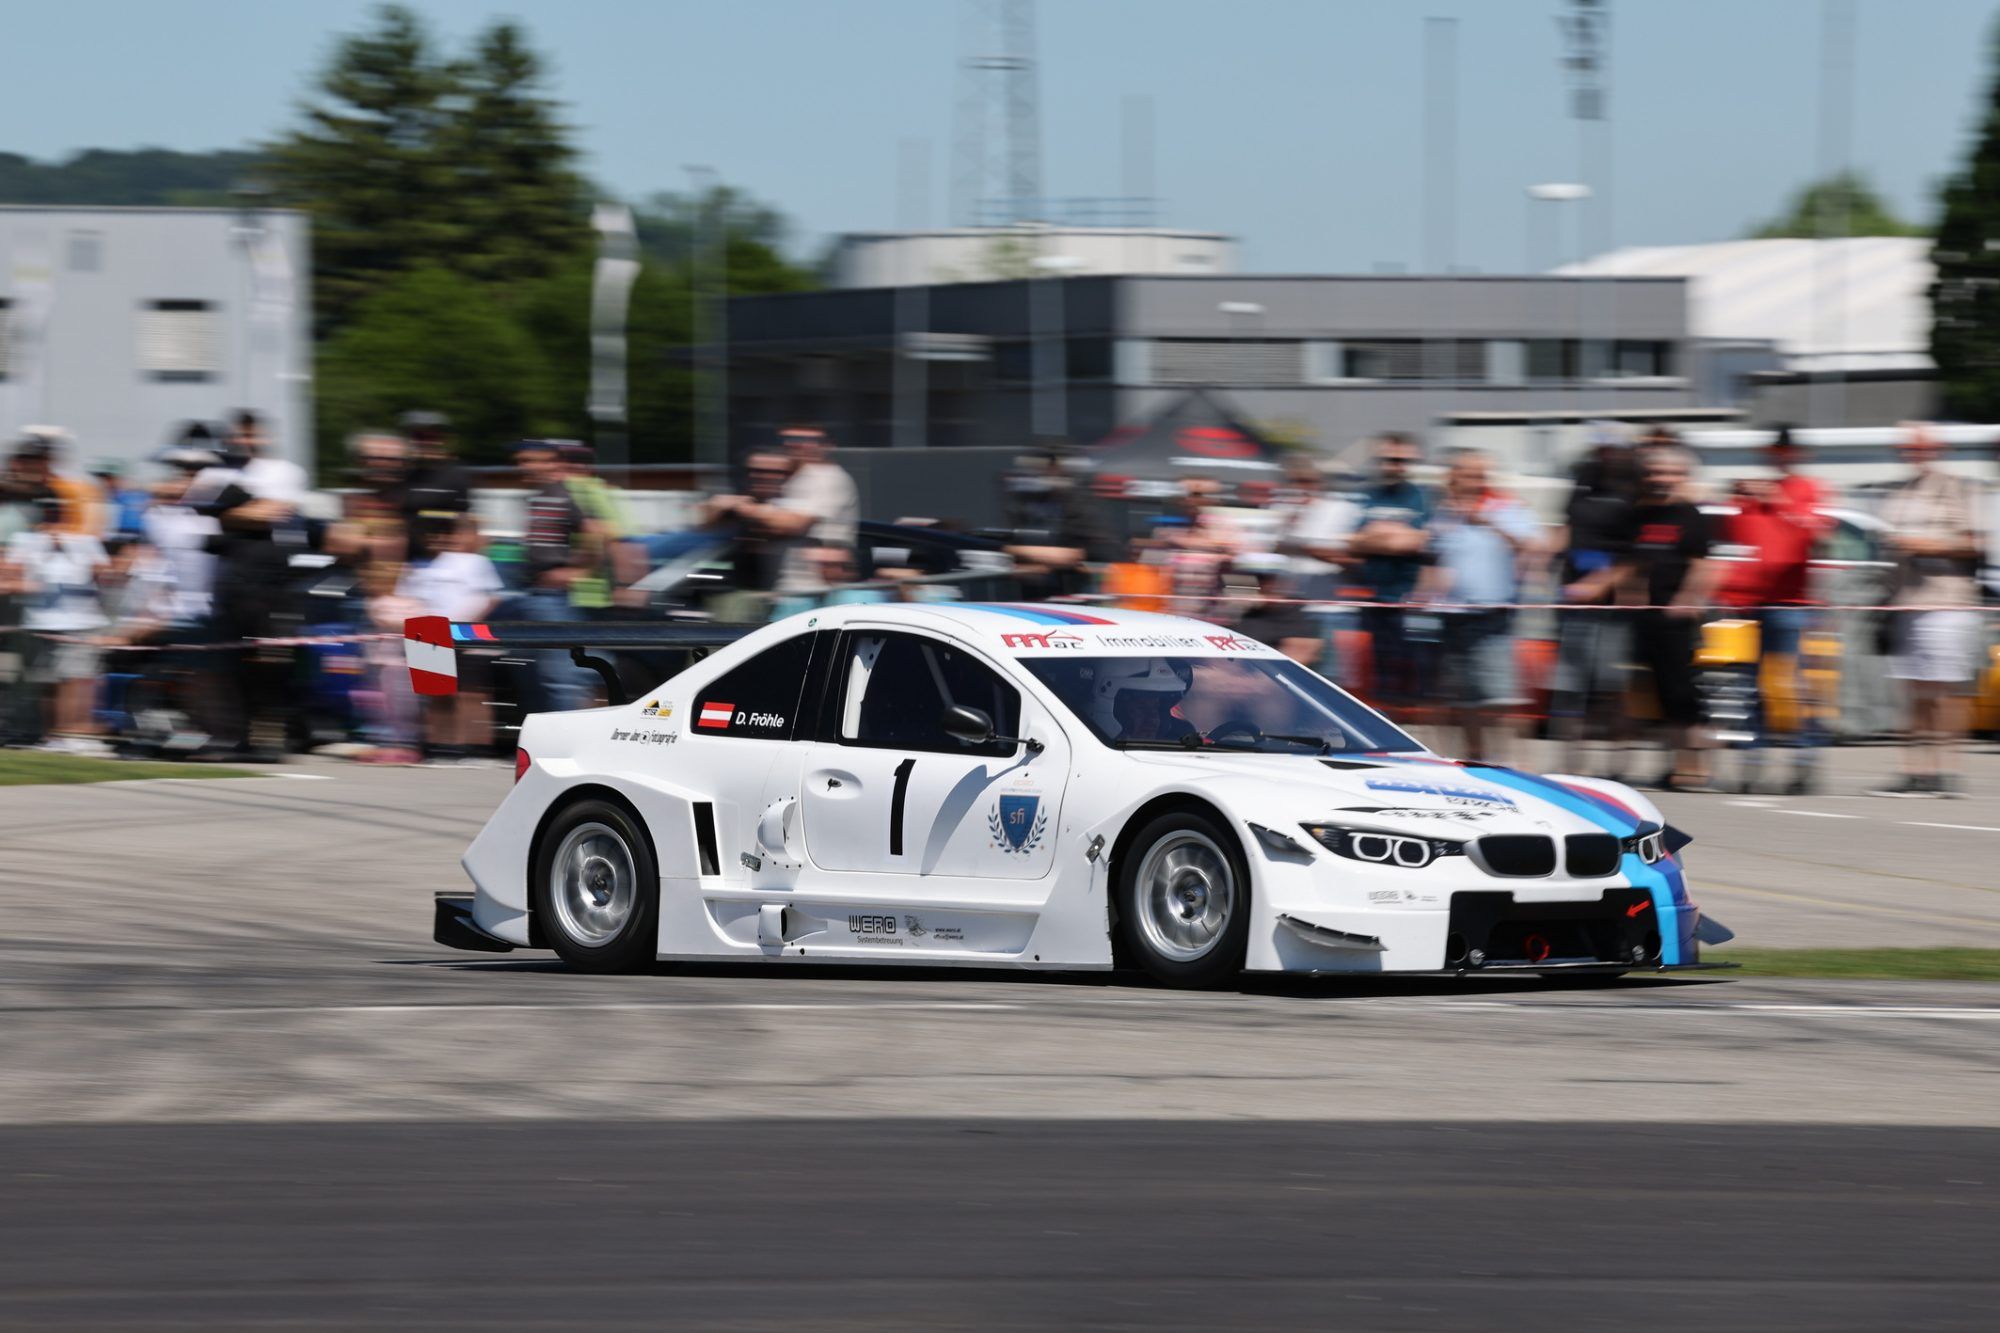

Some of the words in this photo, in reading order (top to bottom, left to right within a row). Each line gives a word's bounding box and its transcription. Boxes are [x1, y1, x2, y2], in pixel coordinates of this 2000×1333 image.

[1096, 634, 1204, 648] Immobilien
[735, 711, 747, 725] D.
[749, 712, 785, 728] Fröhle
[890, 758, 916, 855] 1
[1010, 807, 1025, 825] sfi
[848, 915, 896, 934] WERO
[857, 936, 903, 946] Systembetreuung
